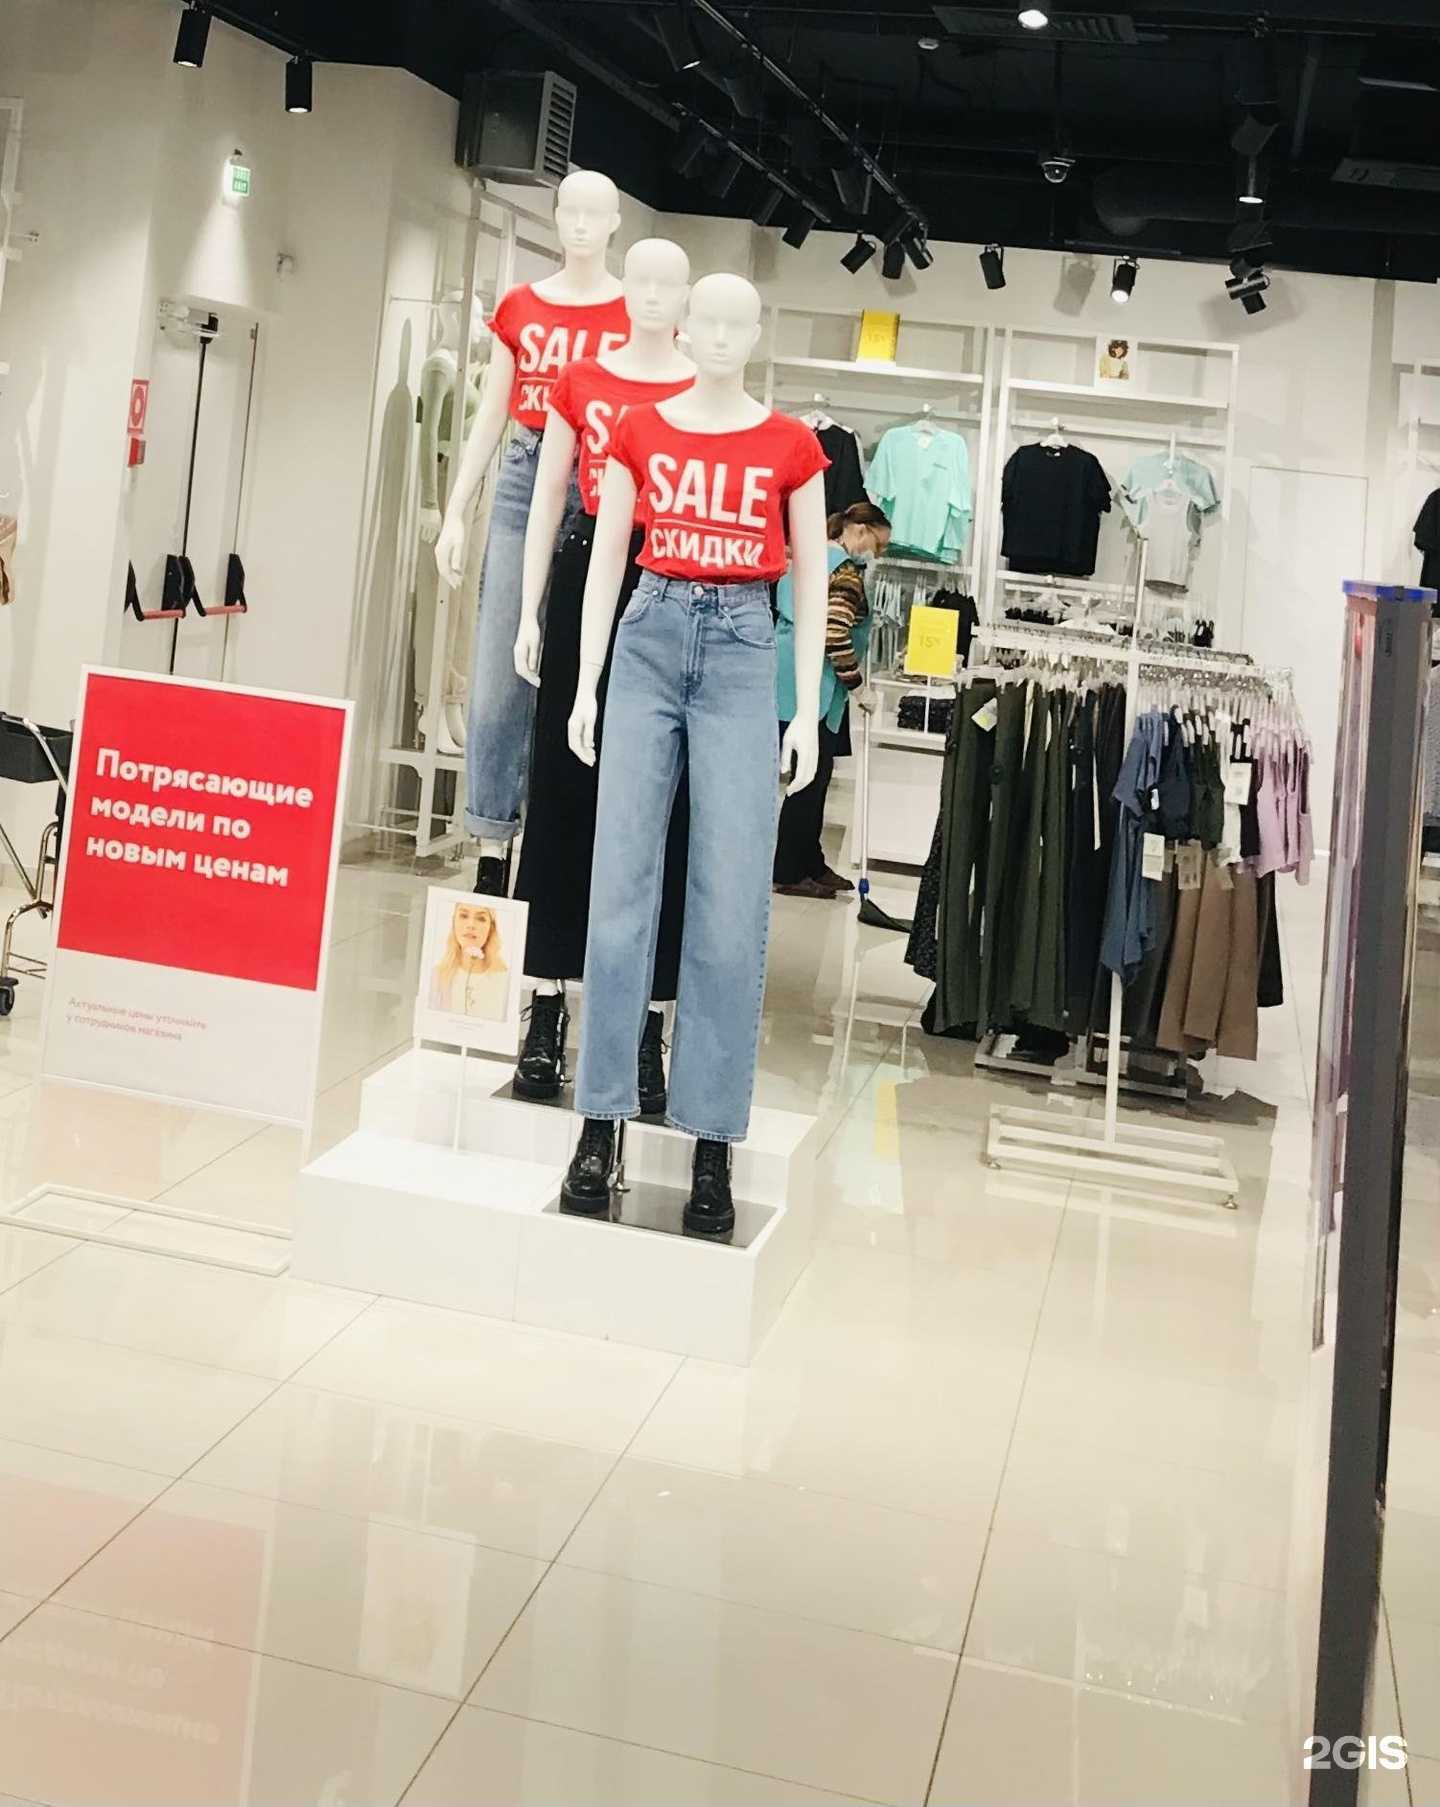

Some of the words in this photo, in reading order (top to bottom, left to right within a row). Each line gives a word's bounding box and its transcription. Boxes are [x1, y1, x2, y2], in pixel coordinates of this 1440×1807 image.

[648, 453, 774, 529] SALE
[651, 528, 765, 569] СКИДКИ
[96, 748, 314, 808] Потрясающие
[91, 796, 205, 832] модели
[212, 815, 251, 839] по
[86, 836, 187, 870] новым
[193, 853, 289, 887] ценам
